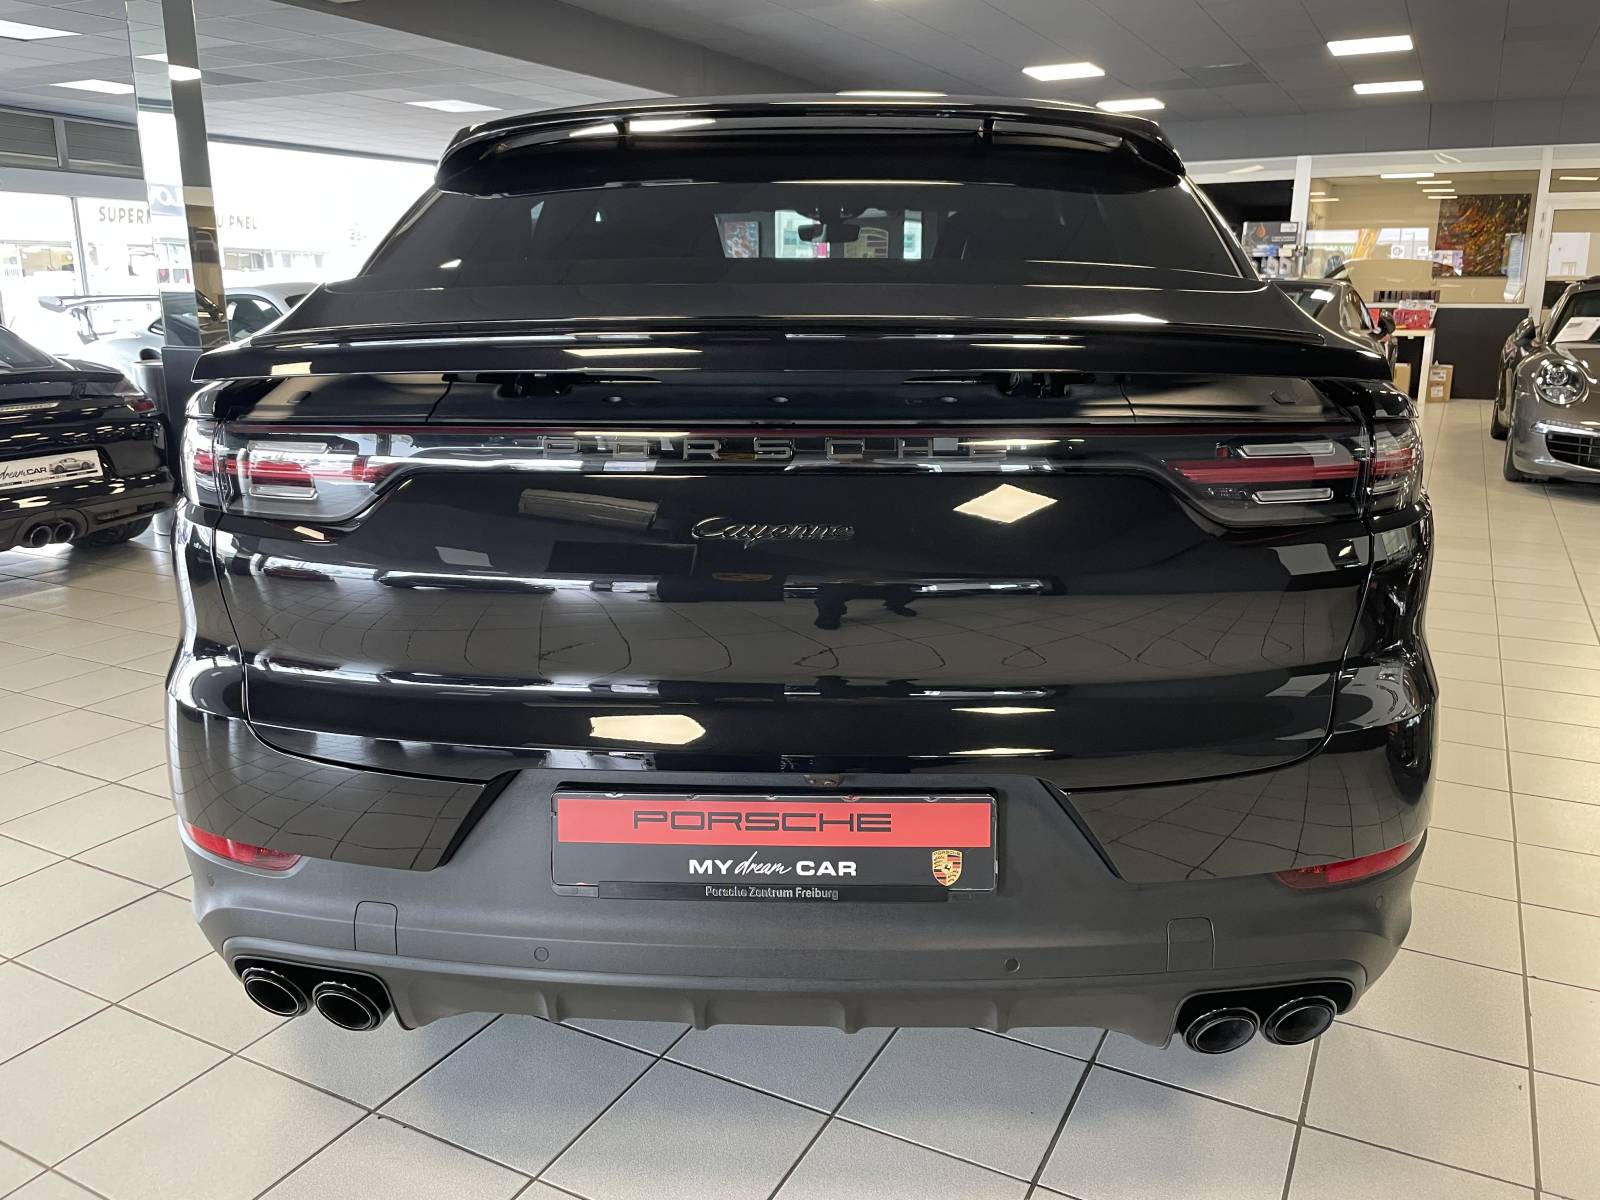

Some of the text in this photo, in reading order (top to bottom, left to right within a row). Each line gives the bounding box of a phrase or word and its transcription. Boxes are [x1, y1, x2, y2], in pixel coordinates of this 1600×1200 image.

[541, 435, 1010, 461] PORSCHE
[26, 466, 47, 475] CAR
[691, 516, 855, 550] Cayenne
[633, 810, 892, 832] PORSCHE
[688, 851, 857, 877] MY dream CAR
[705, 885, 839, 900] Porsche Zentrum Freiburg
